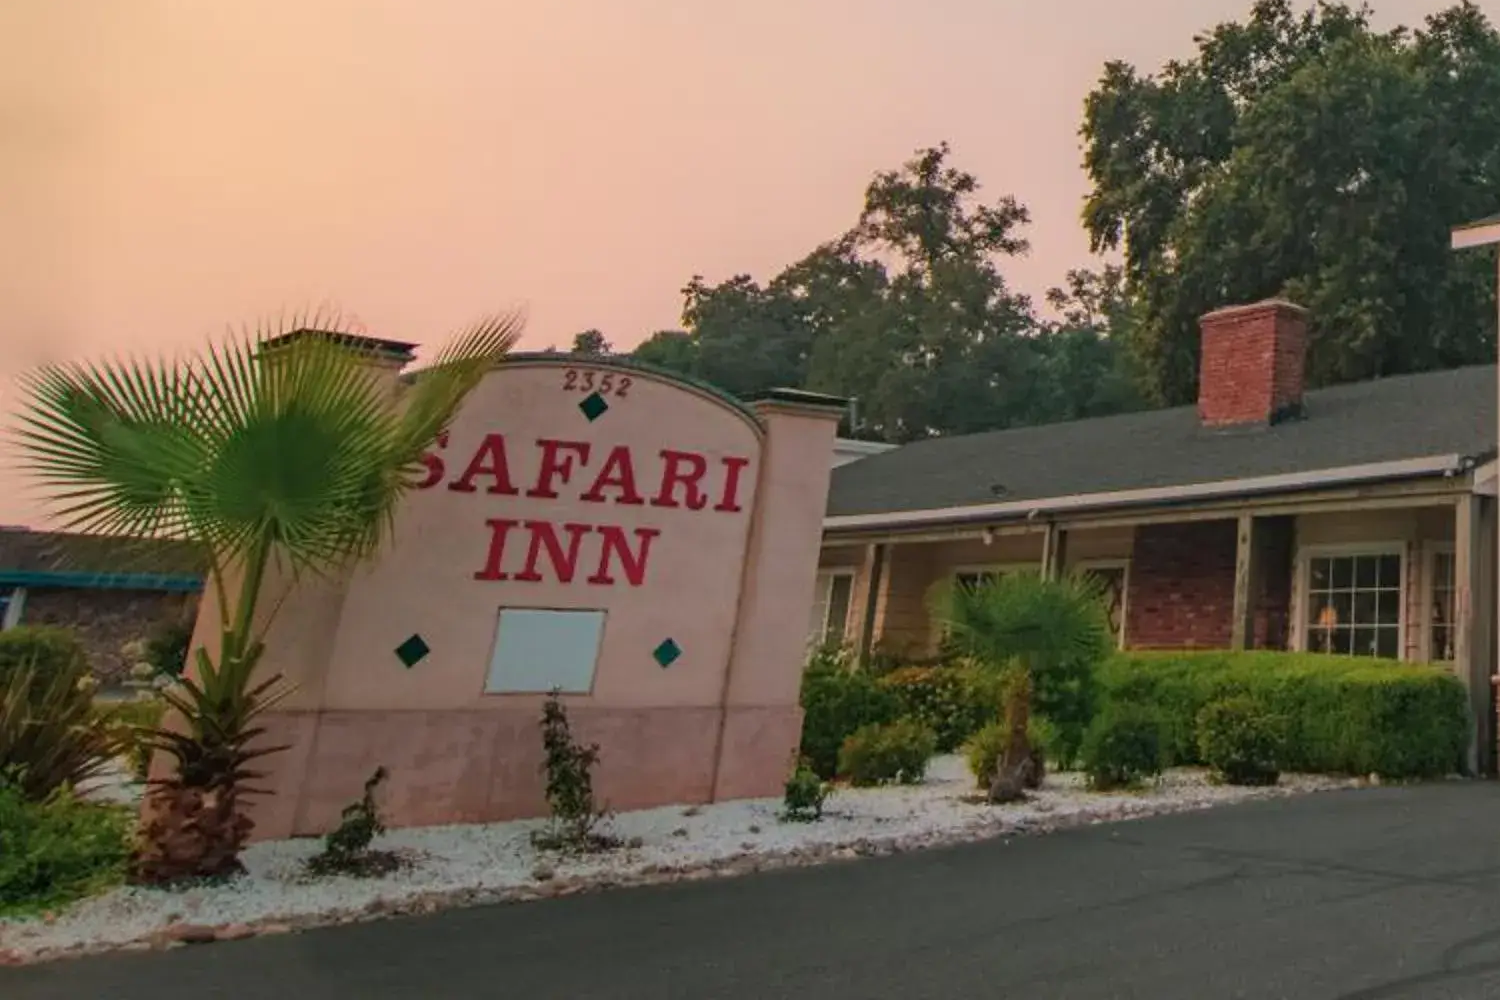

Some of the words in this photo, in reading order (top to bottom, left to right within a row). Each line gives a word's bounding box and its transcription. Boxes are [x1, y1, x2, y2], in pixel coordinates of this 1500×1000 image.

[563, 369, 633, 398] 2352
[408, 430, 749, 513] SAFARI
[473, 518, 662, 587] INN
